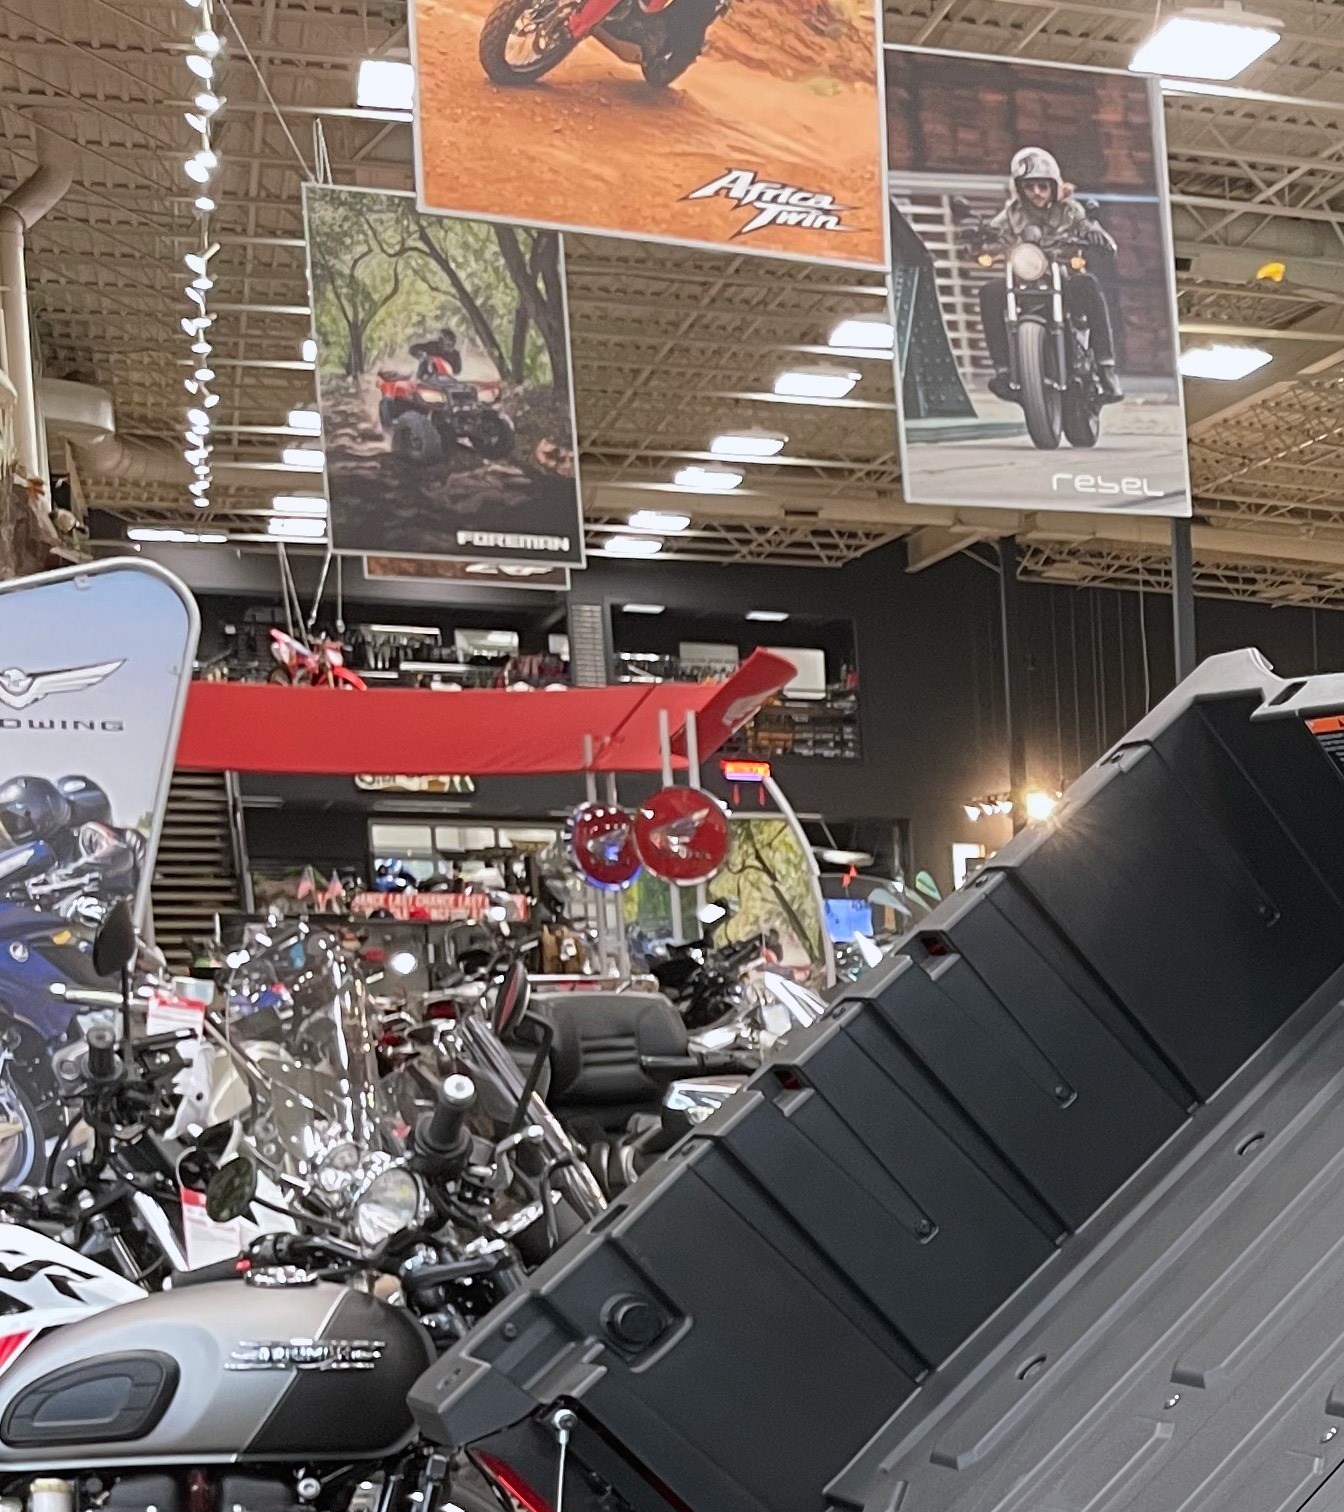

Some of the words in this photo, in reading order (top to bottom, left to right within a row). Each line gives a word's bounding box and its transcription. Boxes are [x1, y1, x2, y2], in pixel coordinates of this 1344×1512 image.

[679, 167, 860, 210] Africa
[730, 201, 868, 239] Twin
[456, 530, 571, 552] FOREMAN
[0, 718, 124, 732] DWING
